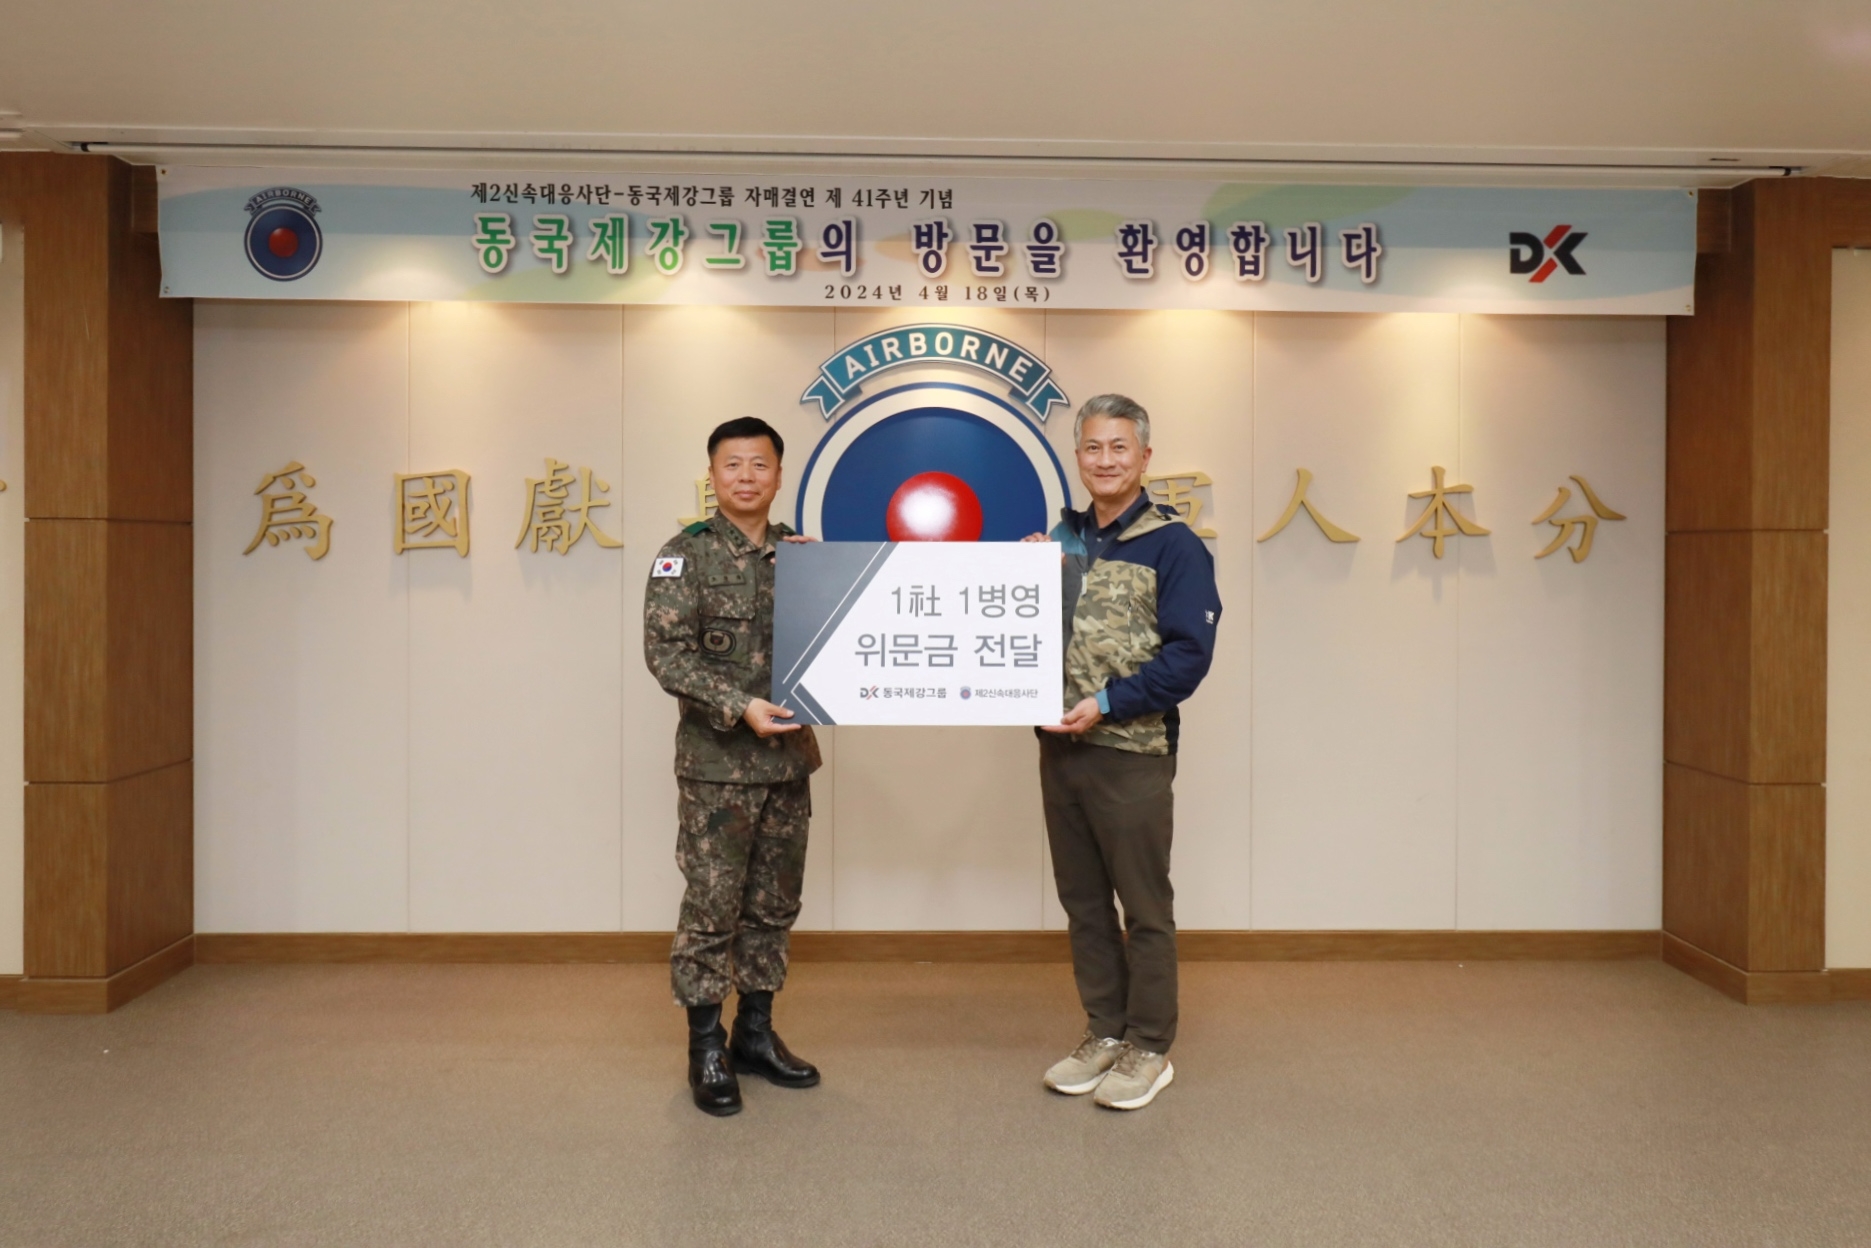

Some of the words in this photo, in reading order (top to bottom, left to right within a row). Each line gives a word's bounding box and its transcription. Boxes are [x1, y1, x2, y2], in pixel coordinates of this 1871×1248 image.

[255, 189, 312, 205] AIRBORNE
[470, 183, 735, 207] 제2신속대응사단-동국제강그룹
[745, 186, 815, 208] 자매결연
[825, 187, 842, 209] 제
[852, 188, 909, 210] 41주년
[919, 188, 954, 210] 기념
[474, 214, 856, 275] 동국제강그룹의
[912, 218, 1063, 277] 방문을
[1116, 221, 1379, 283] 환영합니다
[824, 284, 902, 301] 2024년
[918, 284, 949, 302] 4월
[964, 285, 1050, 303] 18일(목)
[843, 331, 1034, 384] AIRBORNE
[891, 584, 942, 618] 1社
[959, 583, 1040, 619] 1병영
[854, 632, 959, 668] 위문금
[974, 632, 1043, 668] 전달
[883, 686, 947, 700] 동국제강그룹
[974, 687, 1039, 699] 제2신속대응사단
